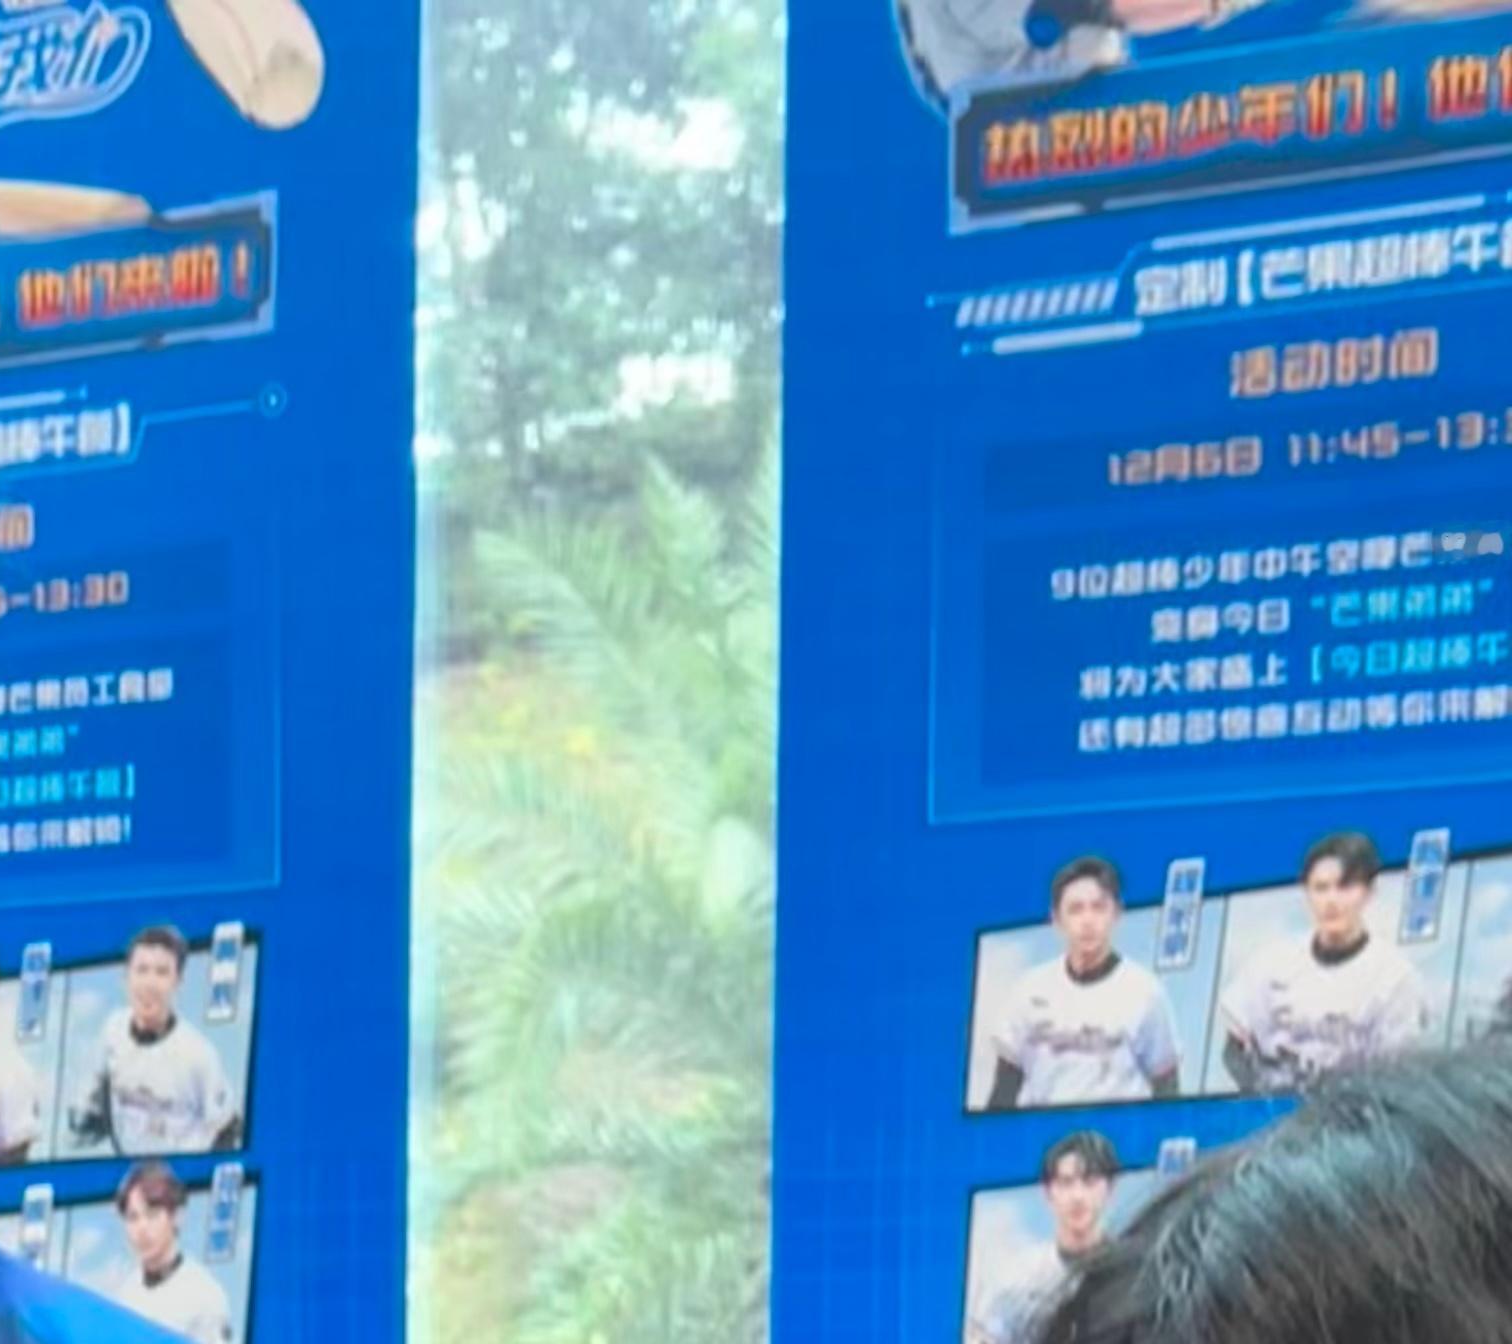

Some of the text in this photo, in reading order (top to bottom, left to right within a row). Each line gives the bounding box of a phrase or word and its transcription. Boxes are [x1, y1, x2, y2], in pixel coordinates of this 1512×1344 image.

[984, 45, 1512, 184] 热烈的少年们！他
[1133, 220, 1512, 317] 定制【芒果超棒午
[1229, 327, 1439, 399] 活动时间
[1108, 435, 1263, 486] 12月6日
[1050, 531, 1504, 600] 9位超棒少年中午空降芒
